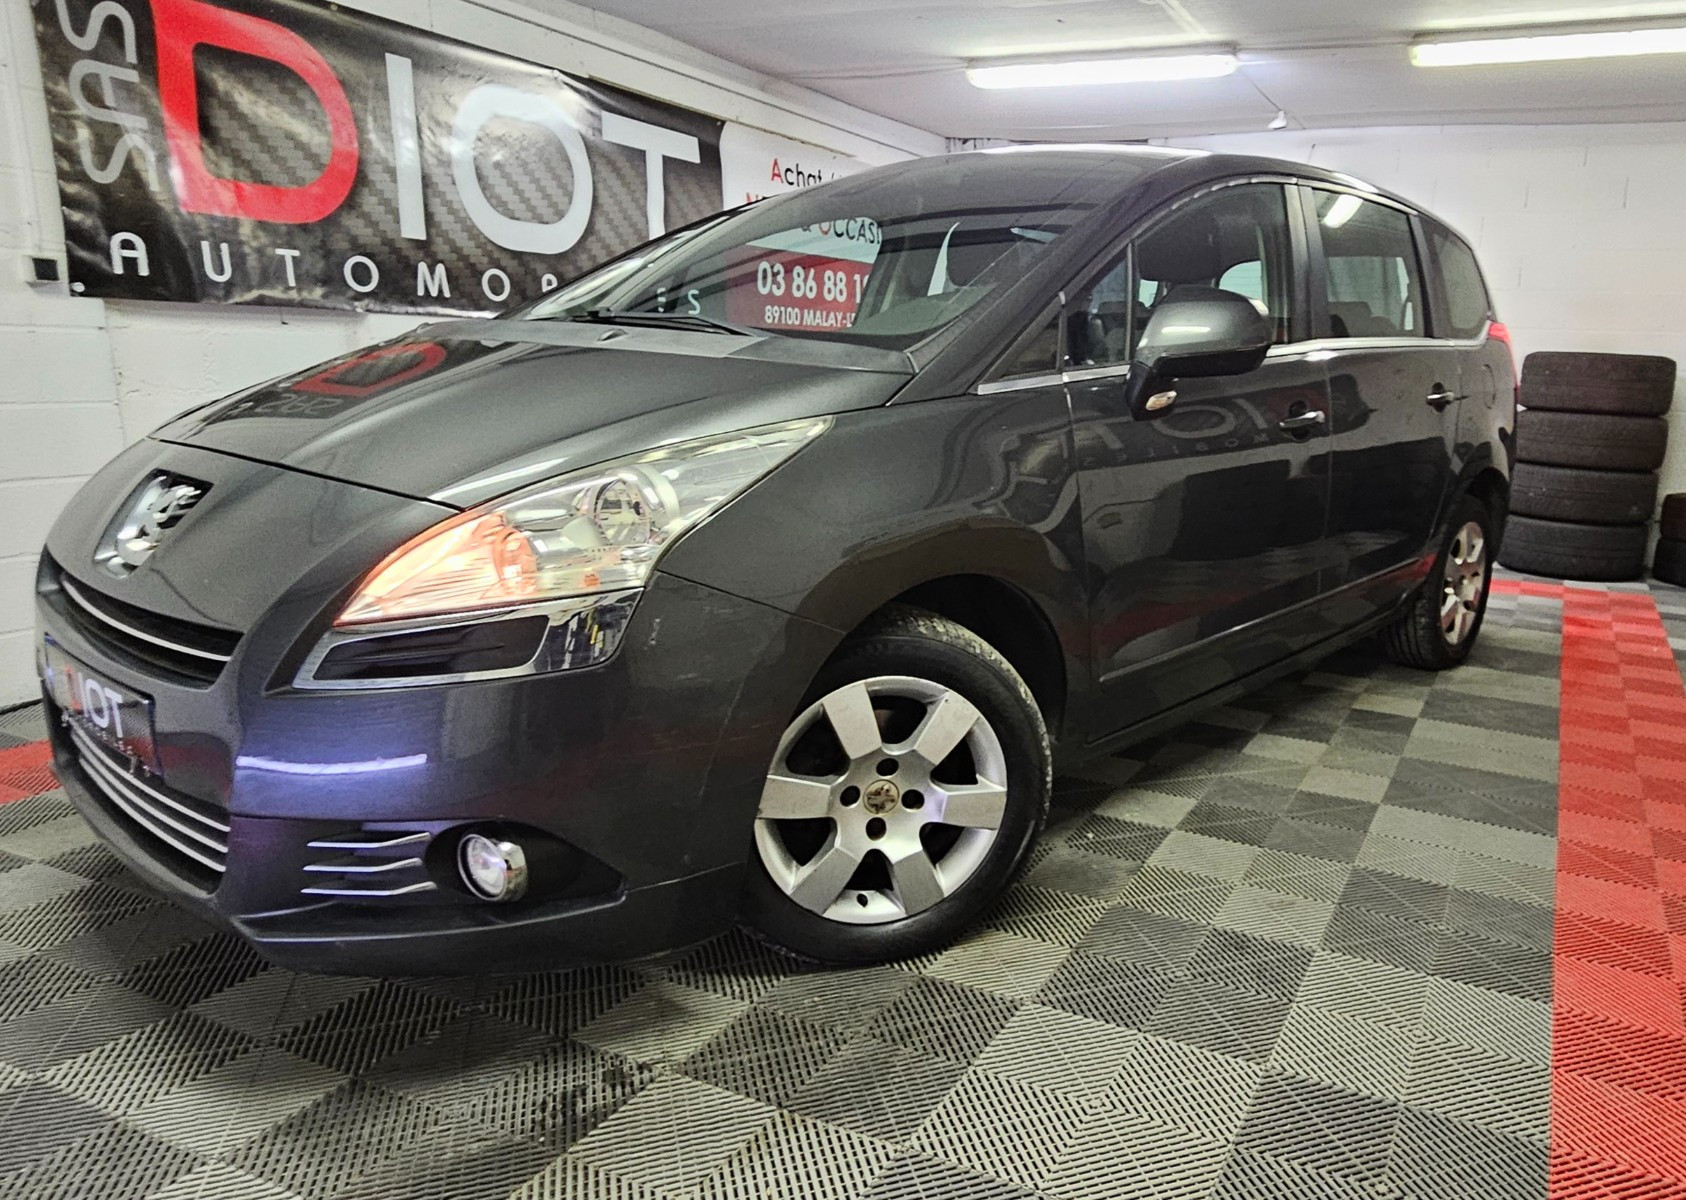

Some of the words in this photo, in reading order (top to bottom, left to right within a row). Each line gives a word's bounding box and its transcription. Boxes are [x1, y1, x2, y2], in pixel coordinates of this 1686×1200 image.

[57, 0, 160, 191] SAS
[147, 0, 700, 255] DIOT
[757, 261, 785, 296] 03
[792, 265, 817, 299] 86
[823, 270, 847, 303] 88
[764, 305, 801, 325] 89100
